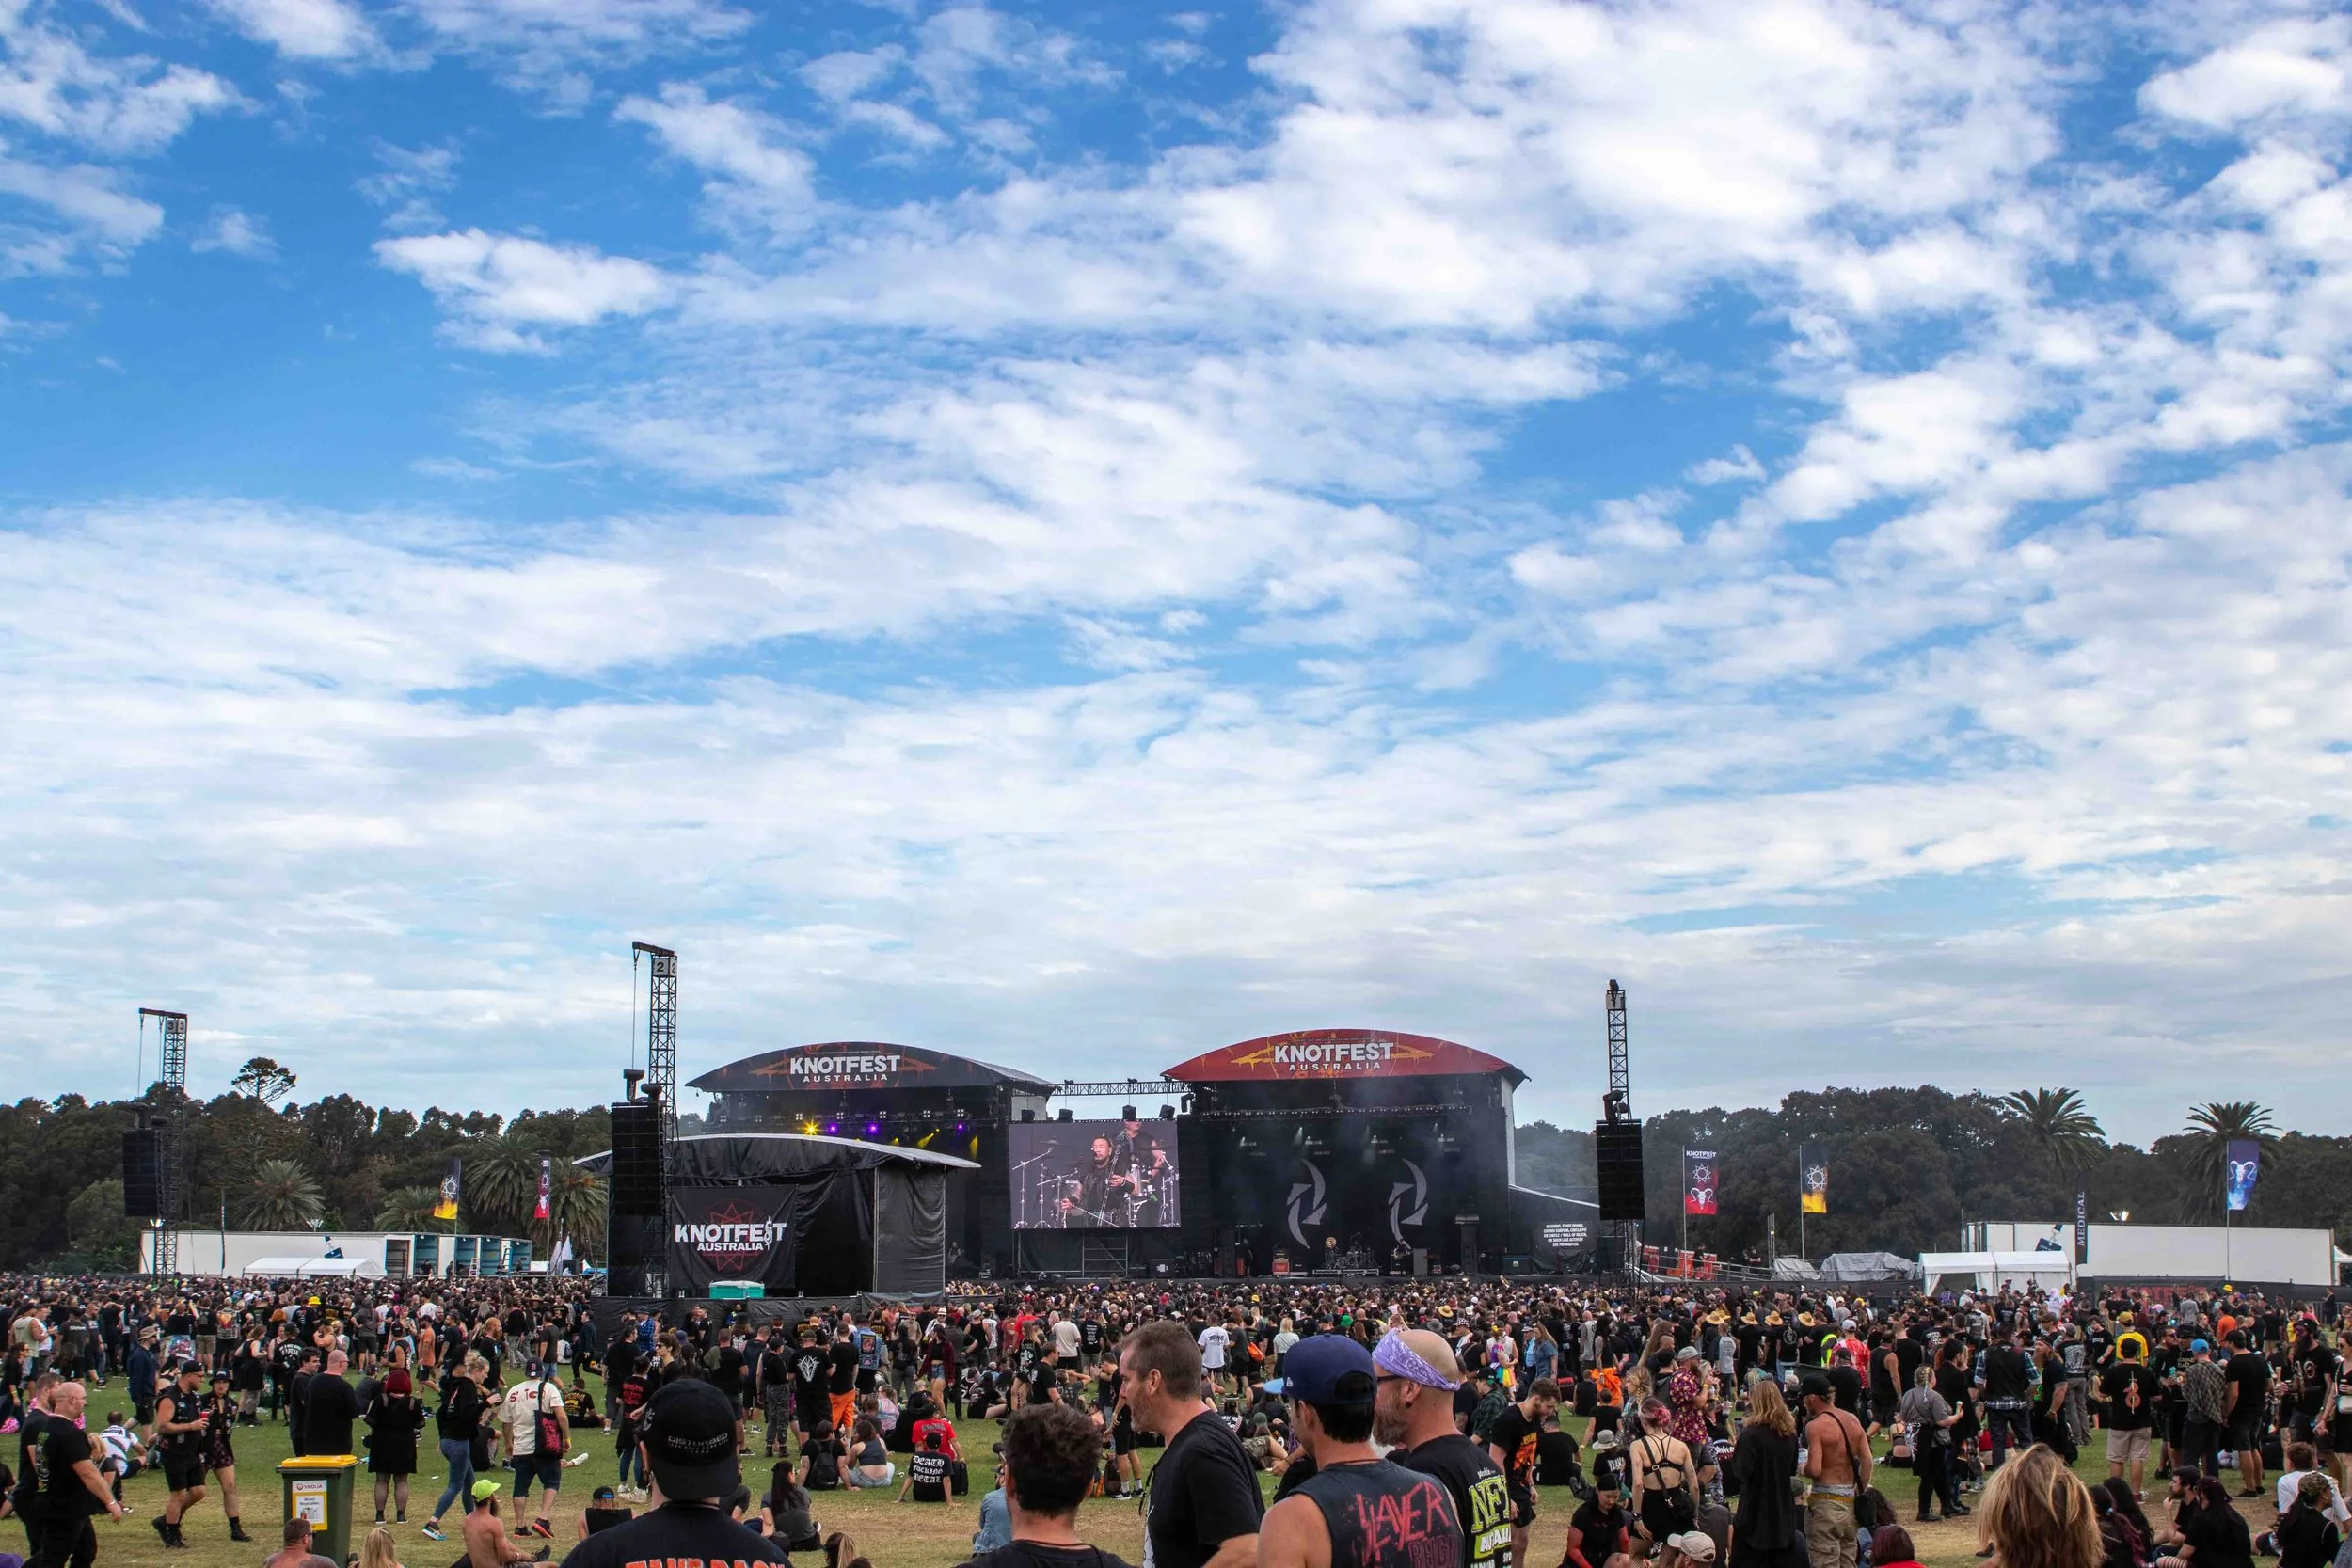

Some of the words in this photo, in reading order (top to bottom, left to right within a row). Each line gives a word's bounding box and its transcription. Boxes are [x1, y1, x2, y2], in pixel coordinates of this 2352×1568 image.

[657, 962, 664, 972] 2
[672, 962, 676, 973] 2
[1274, 1042, 1394, 1063] KNOTFEST
[789, 1055, 901, 1075] KNOTFEST
[1289, 1062, 1380, 1071] AUSTRALIA
[803, 1073, 888, 1083] AUSTRALIA
[675, 1216, 787, 1249] KNOTFEST
[697, 1243, 764, 1252] AUSTRALIA
[668, 1433, 728, 1446] DISTURBED
[913, 1455, 945, 1467] DEATH
